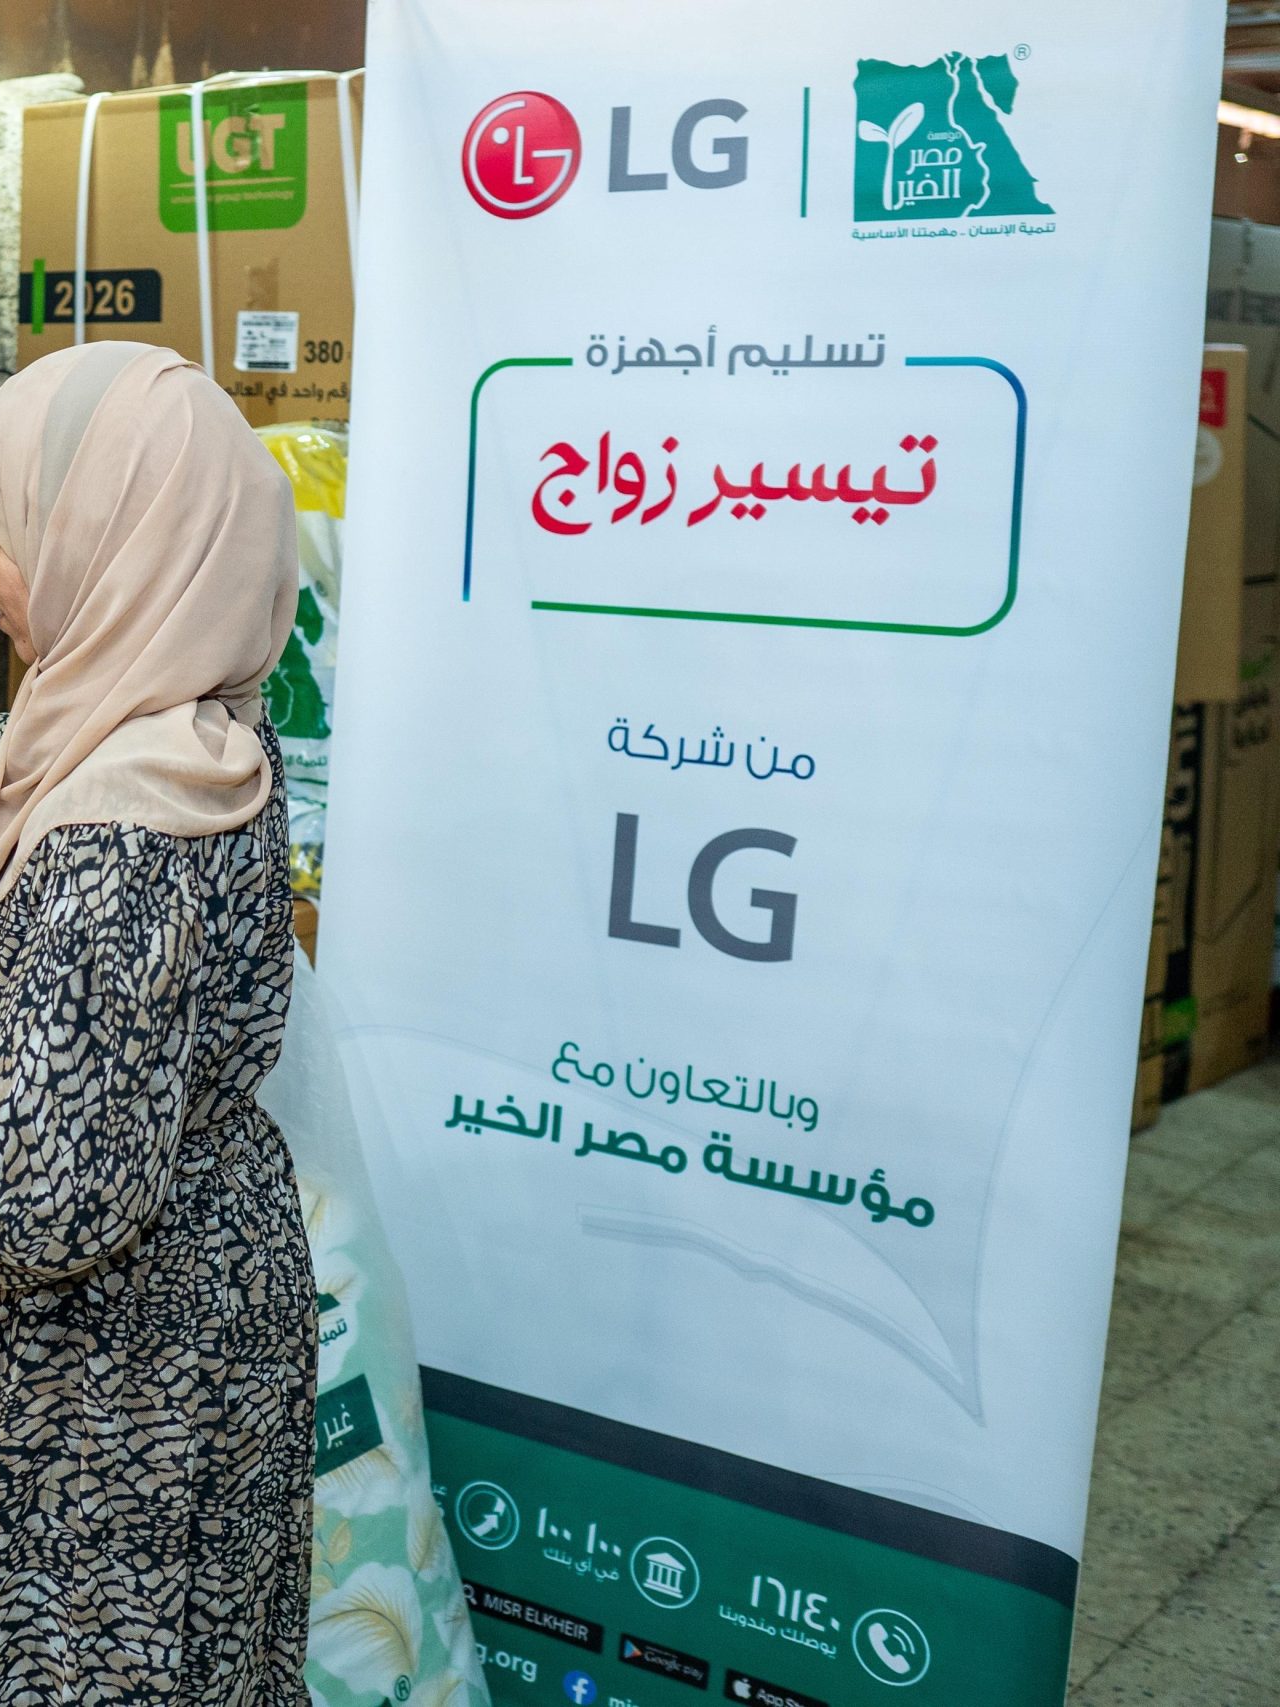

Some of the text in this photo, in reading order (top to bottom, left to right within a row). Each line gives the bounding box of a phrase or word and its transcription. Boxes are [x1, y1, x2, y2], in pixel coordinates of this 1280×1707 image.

[176, 113, 287, 177] UGT
[607, 98, 749, 193] LG
[905, 147, 963, 176] مصر
[892, 168, 962, 211] الخير
[911, 227, 959, 240] مهمتنا
[1018, 221, 1057, 235] تنمية
[304, 340, 343, 363] 380
[585, 325, 886, 376] تسليم أجهزة
[327, 382, 350, 403] قم
[531, 430, 939, 535] تيسير زواج
[607, 717, 817, 781] من شركة
[607, 811, 799, 963] LG
[551, 1040, 821, 1133] وبالتعاون مع
[445, 1094, 936, 1229] مؤسسة مصر الخير
[320, 1317, 348, 1347] تنمي
[543, 1547, 573, 1570] بنك
[593, 1566, 620, 1583] في
[483, 1593, 591, 1643] MISR ELKHEIR
[718, 1604, 837, 1660] يوصلك مندوبنا
[643, 1650, 682, 1672] Google
